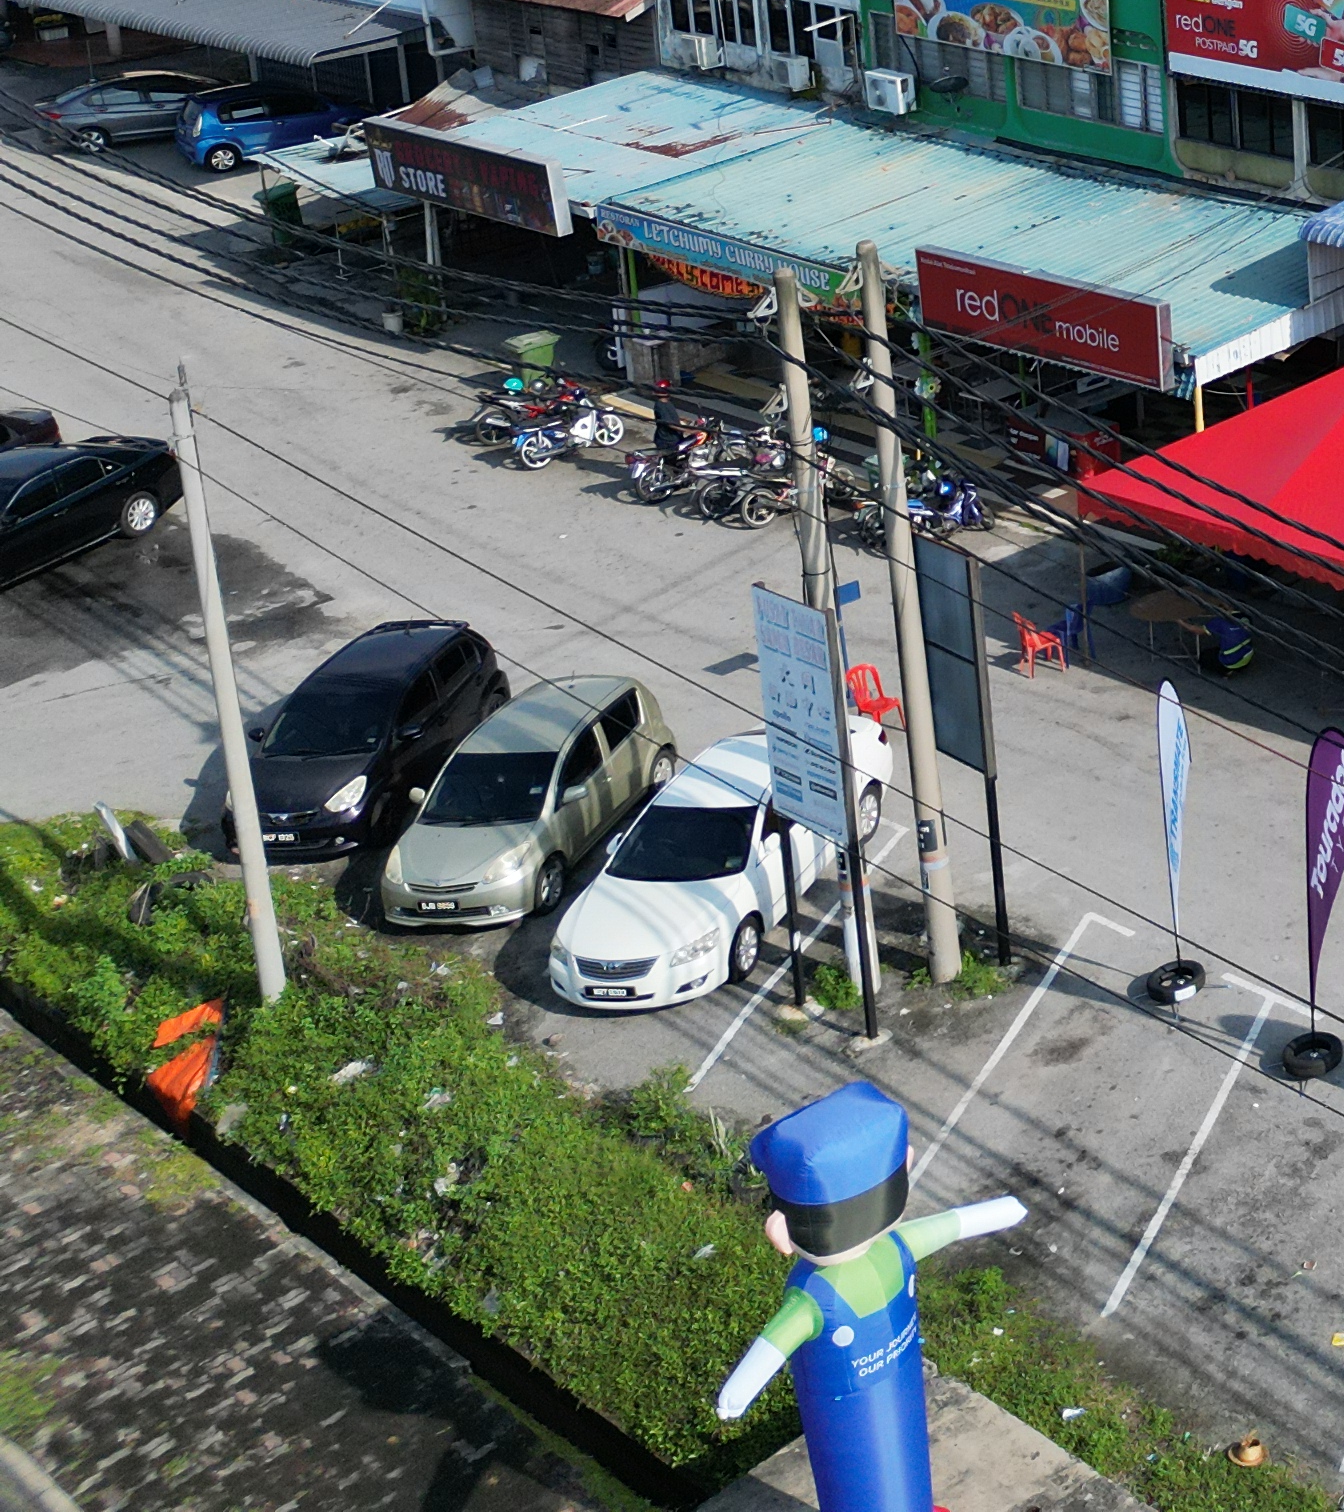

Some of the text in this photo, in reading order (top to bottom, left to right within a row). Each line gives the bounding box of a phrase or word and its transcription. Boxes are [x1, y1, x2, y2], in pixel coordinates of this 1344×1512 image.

[1175, 13, 1236, 38] redONE
[1294, 14, 1317, 37] 5G
[1195, 36, 1258, 59] POSTPAID 5G
[399, 165, 446, 198] STORE
[600, 210, 640, 227] RESTORAN
[643, 221, 723, 258] LETCHUMY
[725, 245, 773, 274] CURRY
[956, 287, 1120, 352] redONE mobile
[851, 1348, 884, 1369] YOUR
[859, 1359, 885, 1377] OUR
